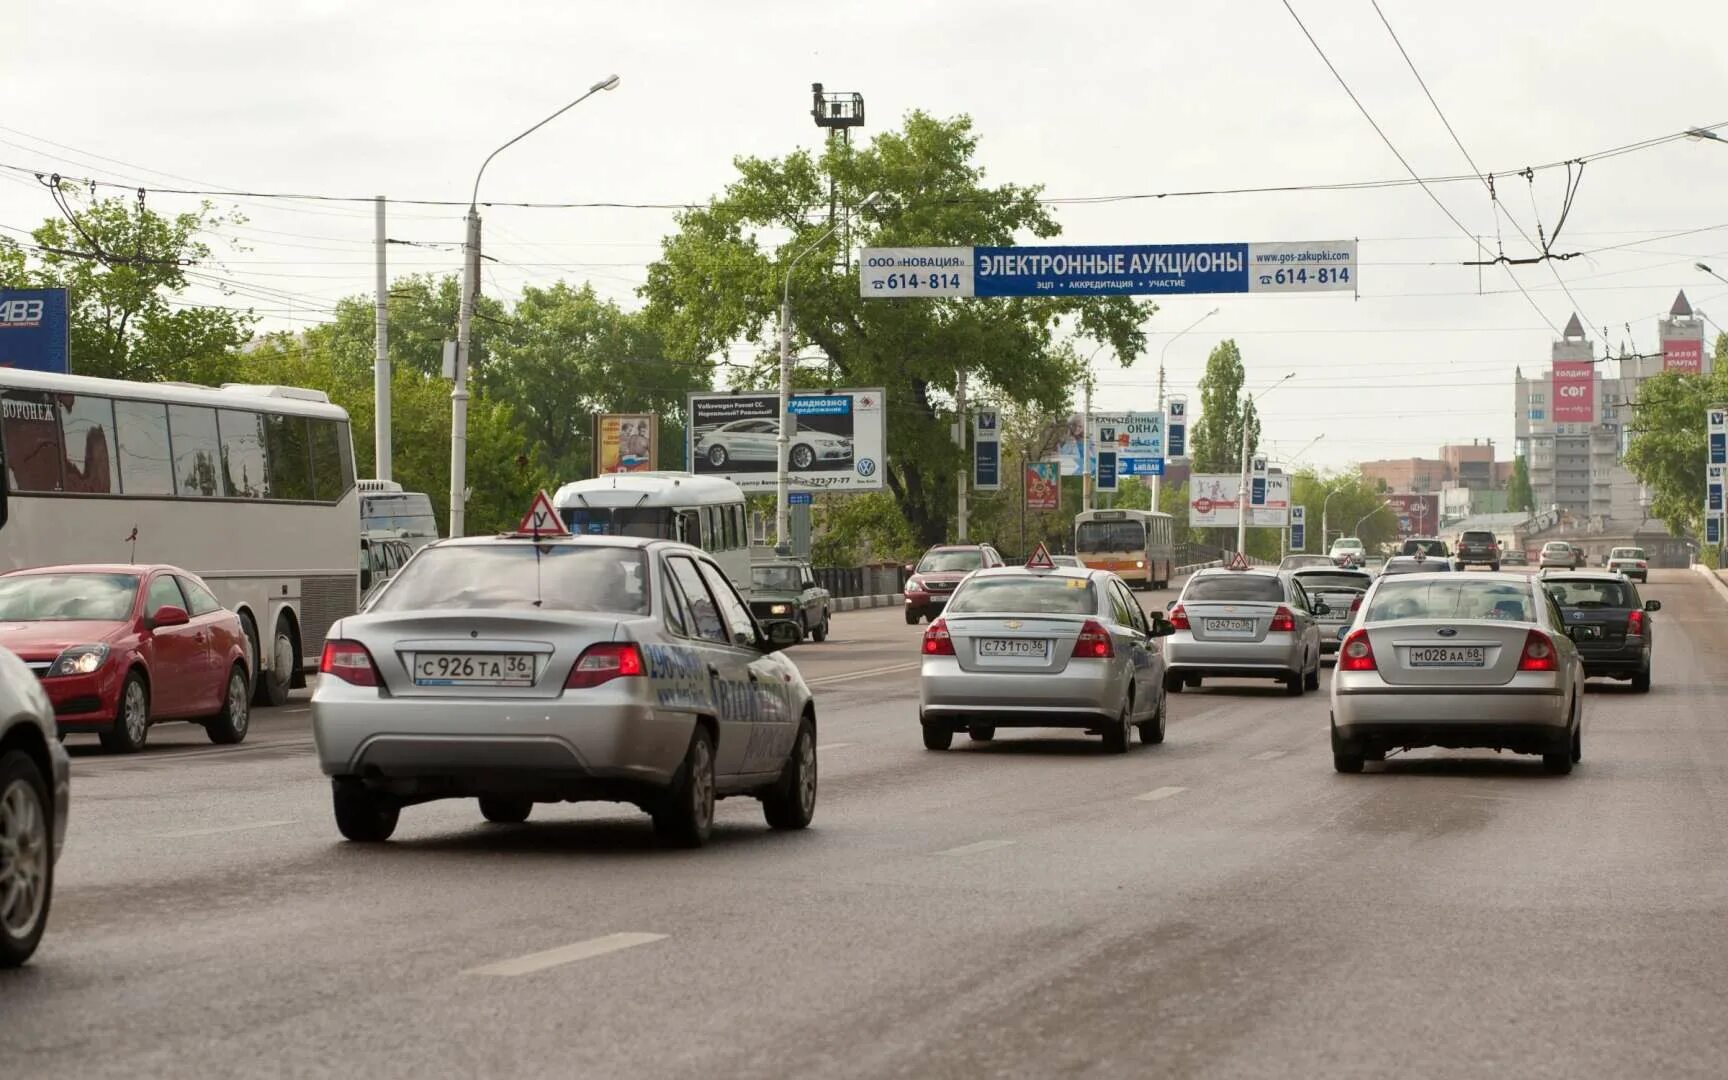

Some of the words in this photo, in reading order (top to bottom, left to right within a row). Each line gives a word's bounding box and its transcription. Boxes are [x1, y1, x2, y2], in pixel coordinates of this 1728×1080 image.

[868, 258, 894, 267] ООО
[898, 257, 964, 269] «НОВАЦИЯ»
[980, 254, 1125, 276] ЭЛЕКТРОННЫЕ
[1129, 252, 1243, 277] АУКЦИОНЫ
[1256, 250, 1349, 264] www.gos-zakupki.com
[887, 273, 960, 289] 614-814
[1275, 268, 1350, 284] 614-814
[1069, 281, 1134, 290] АККРЕДИТАЦИЯ
[1149, 279, 1185, 288] УЧАСТИЕ
[2, 400, 55, 421] ВОРОНЕЖ
[1127, 424, 1159, 433] ОКНА
[507, 656, 526, 671] 36
